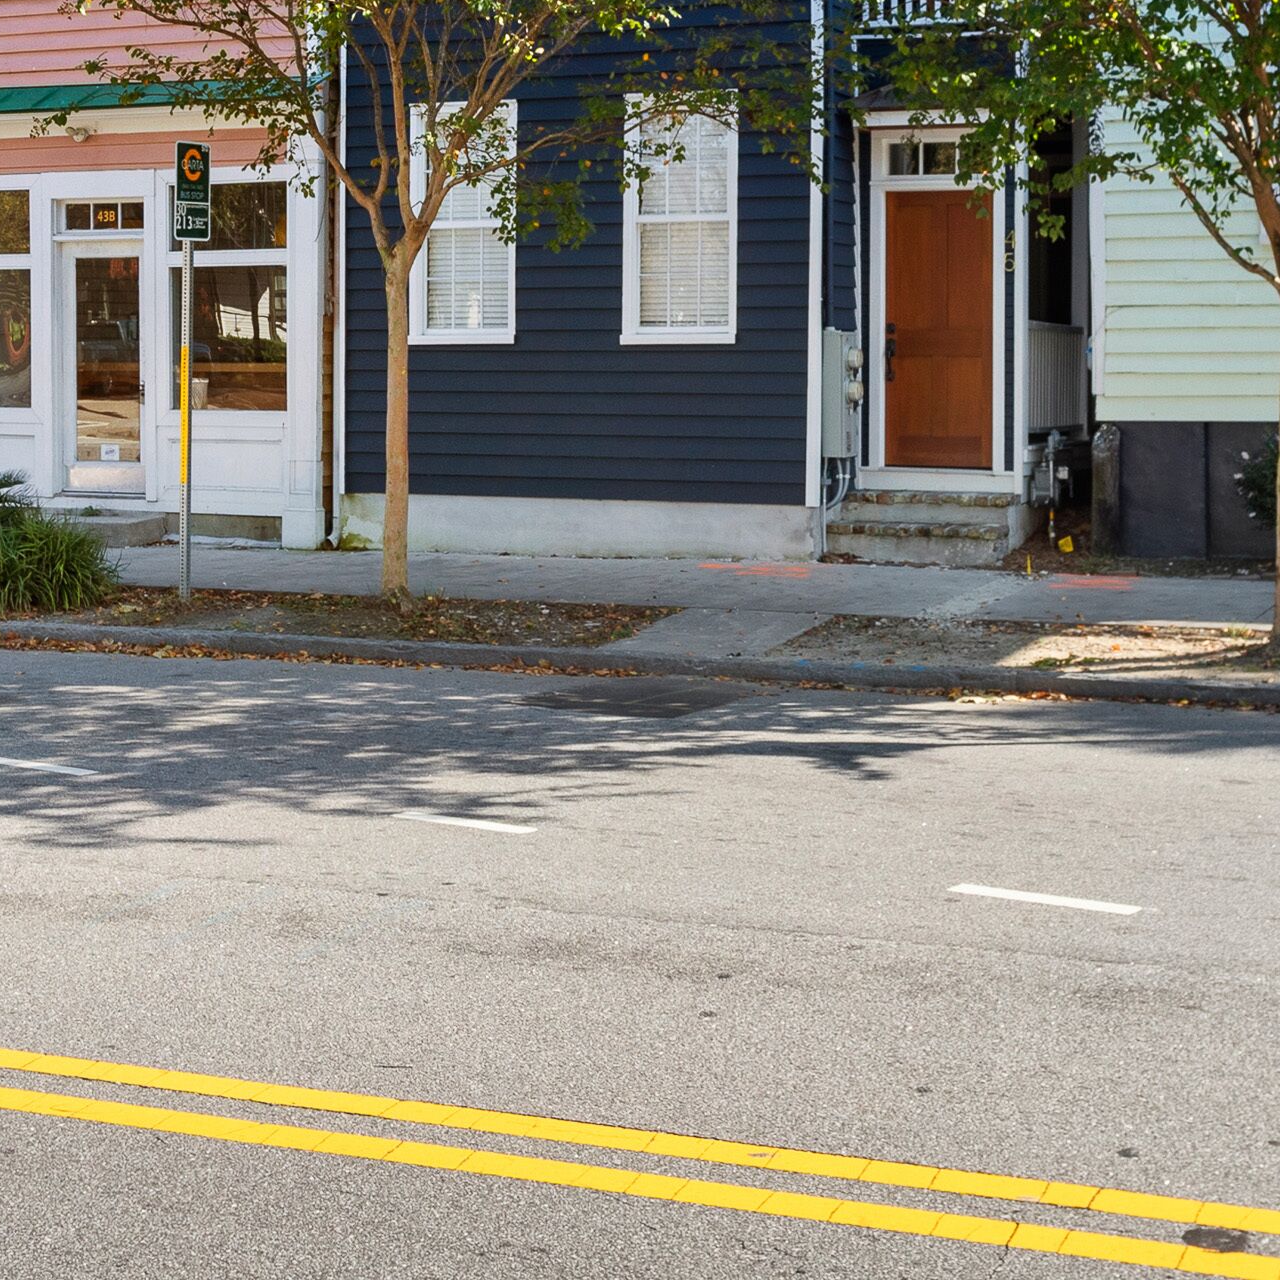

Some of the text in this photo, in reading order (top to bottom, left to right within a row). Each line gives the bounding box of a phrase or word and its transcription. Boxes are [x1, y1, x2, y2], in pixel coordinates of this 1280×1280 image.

[181, 158, 204, 170] CARTA
[191, 191, 205, 200] STOP
[176, 203, 187, 216] 30
[97, 210, 116, 222] 43B
[176, 215, 193, 230] 213
